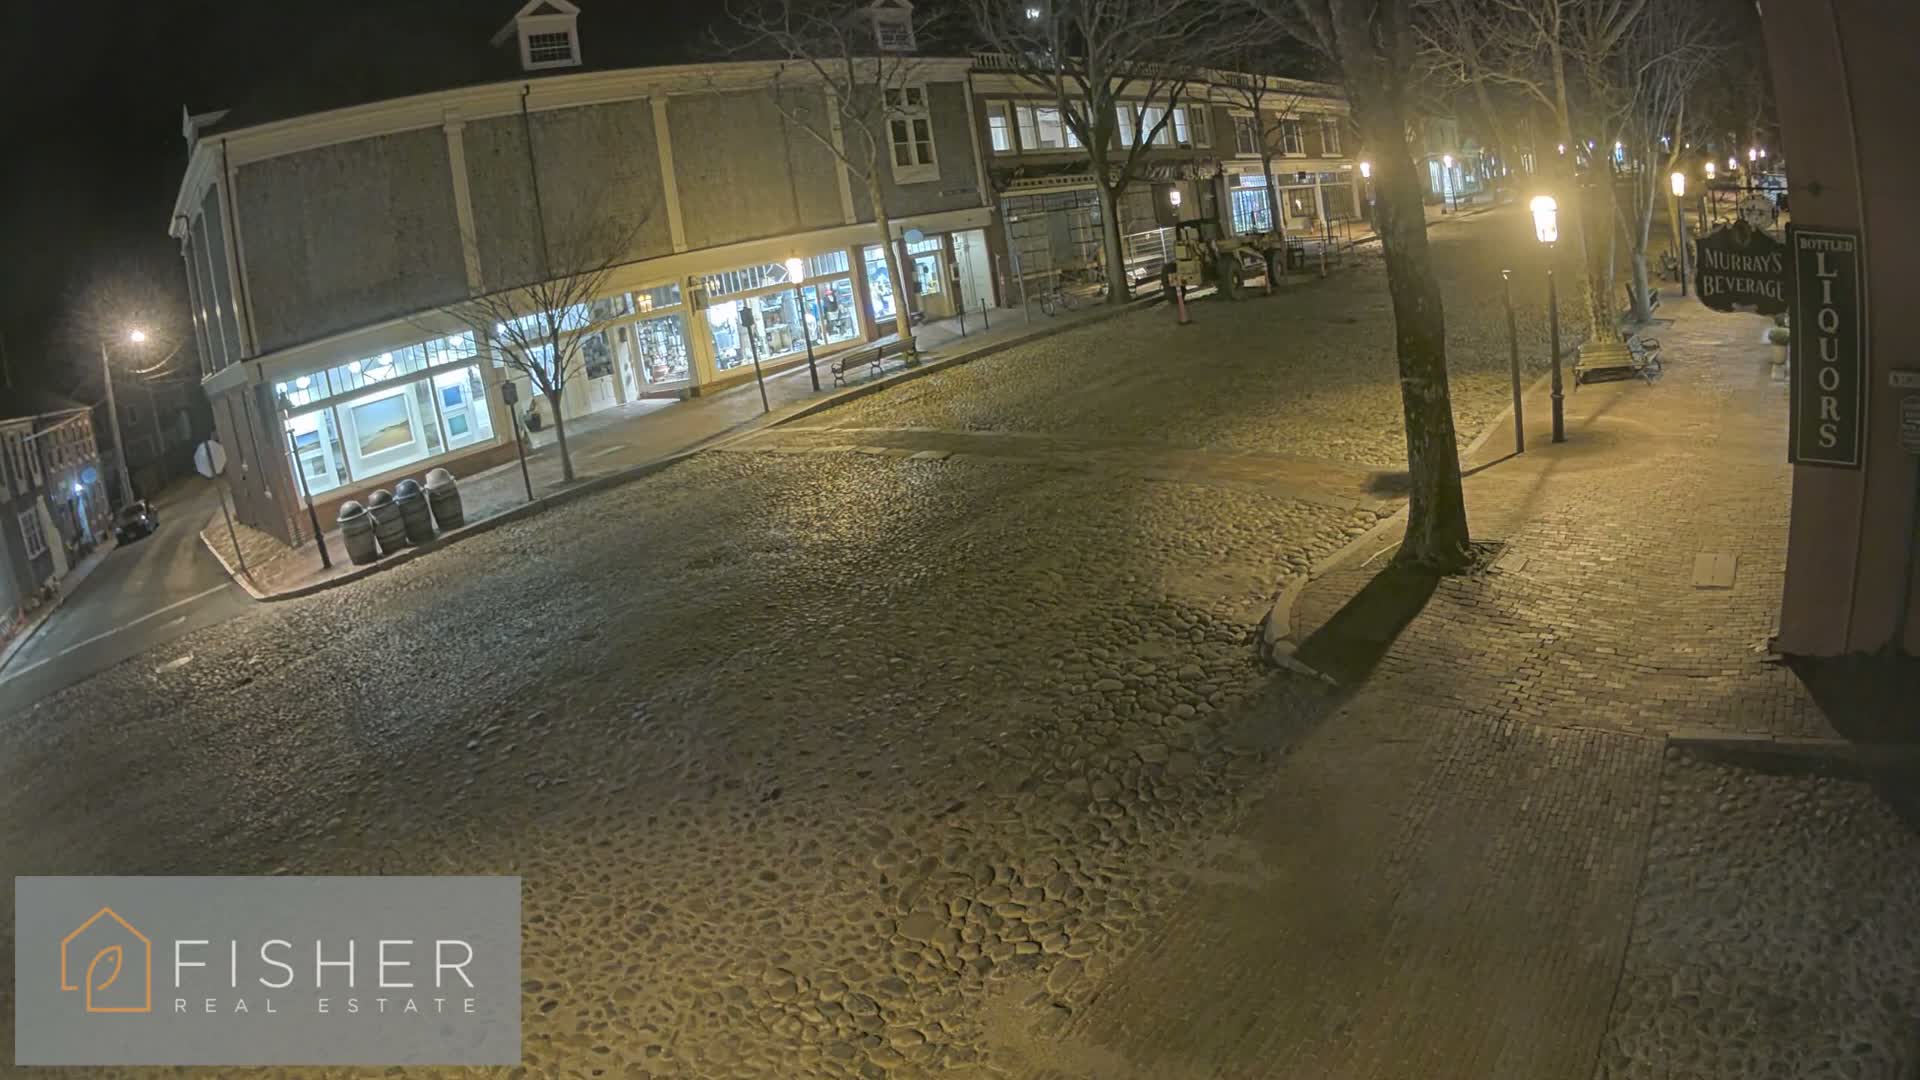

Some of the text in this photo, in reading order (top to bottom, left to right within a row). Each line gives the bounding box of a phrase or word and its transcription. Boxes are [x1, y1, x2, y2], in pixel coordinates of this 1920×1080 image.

[1800, 237, 1853, 252] BOTTLED
[1704, 247, 1783, 274] MURRAY'S
[1703, 275, 1785, 302] BEVERAGE
[1816, 252, 1841, 448] LIQUORS
